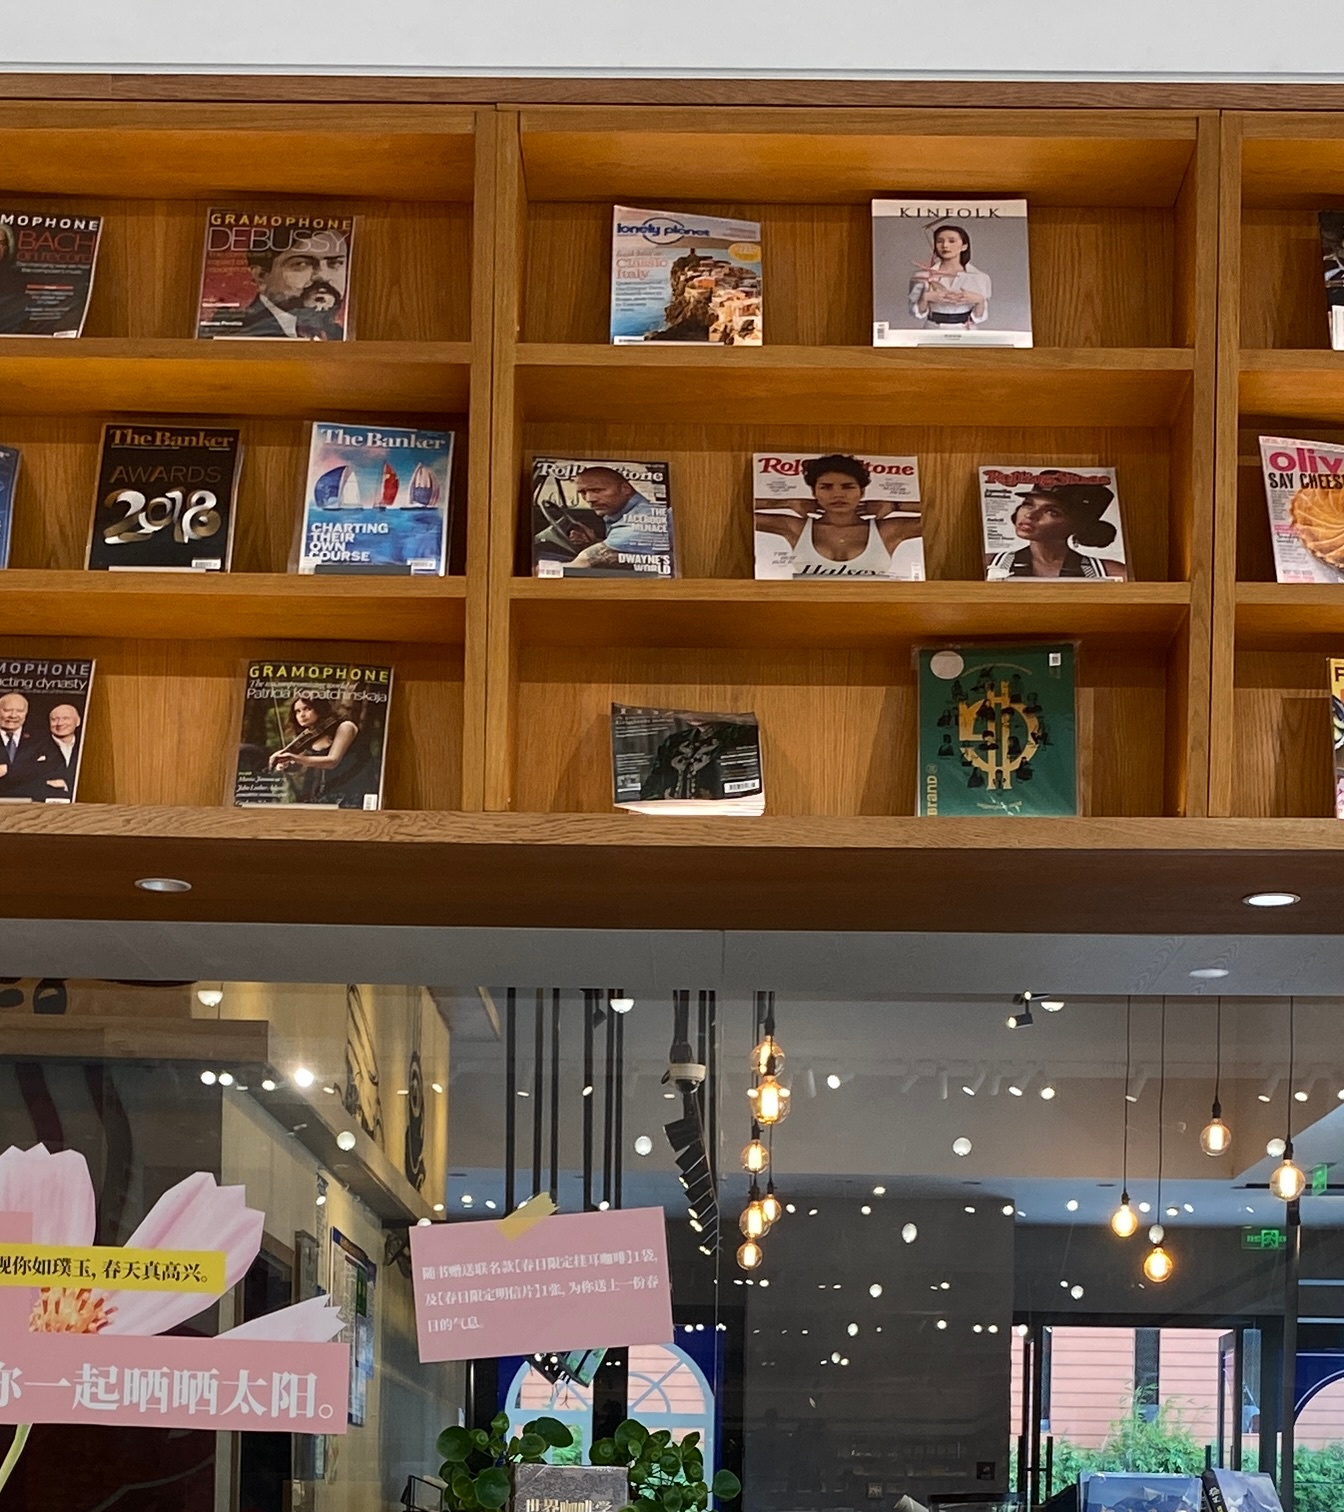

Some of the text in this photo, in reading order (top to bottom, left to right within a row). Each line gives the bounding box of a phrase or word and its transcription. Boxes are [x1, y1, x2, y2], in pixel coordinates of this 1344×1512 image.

[899, 206, 1002, 219] KINFOLK
[211, 213, 352, 231] GRAMOPHONE
[617, 222, 710, 240] lonely planet
[17, 230, 95, 253] BACH
[207, 228, 349, 253] DEBUSSY
[111, 428, 234, 452] The Banker
[320, 428, 447, 452] The Banker
[110, 466, 222, 484] AWARDS
[1268, 471, 1297, 490] SAY
[104, 487, 223, 545] 2018
[311, 522, 389, 535] CHARTING
[309, 541, 346, 552] OWN
[310, 532, 355, 544] THEIR
[309, 550, 371, 563] COURSE
[618, 553, 670, 566] DWAYNE'S
[249, 664, 390, 684] GRAMOPHONE
[36, 677, 88, 691] dynasty
